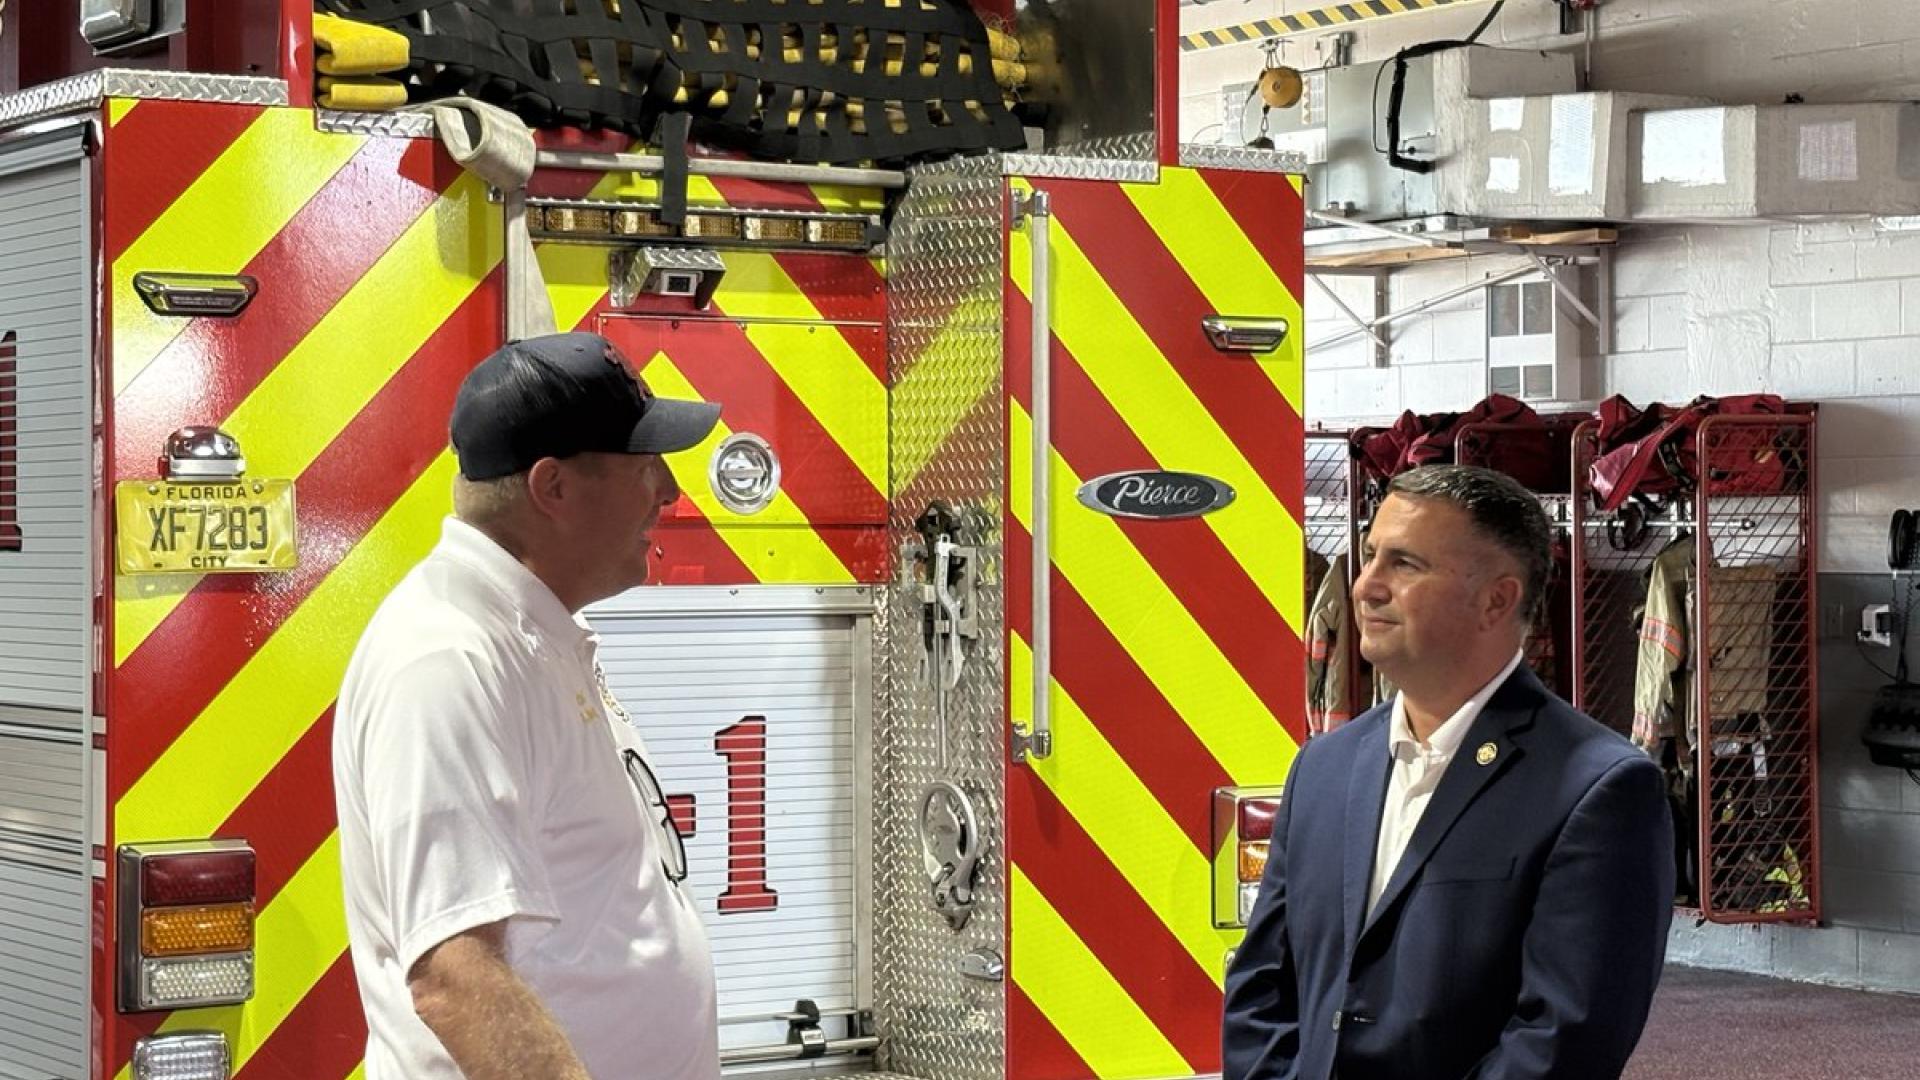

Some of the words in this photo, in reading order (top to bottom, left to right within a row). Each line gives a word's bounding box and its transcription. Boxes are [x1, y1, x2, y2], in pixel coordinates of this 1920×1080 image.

[166, 486, 248, 499] FLORIDA
[1112, 475, 1201, 510] Pierce
[148, 504, 269, 552] XF7283
[191, 555, 229, 569] CITY
